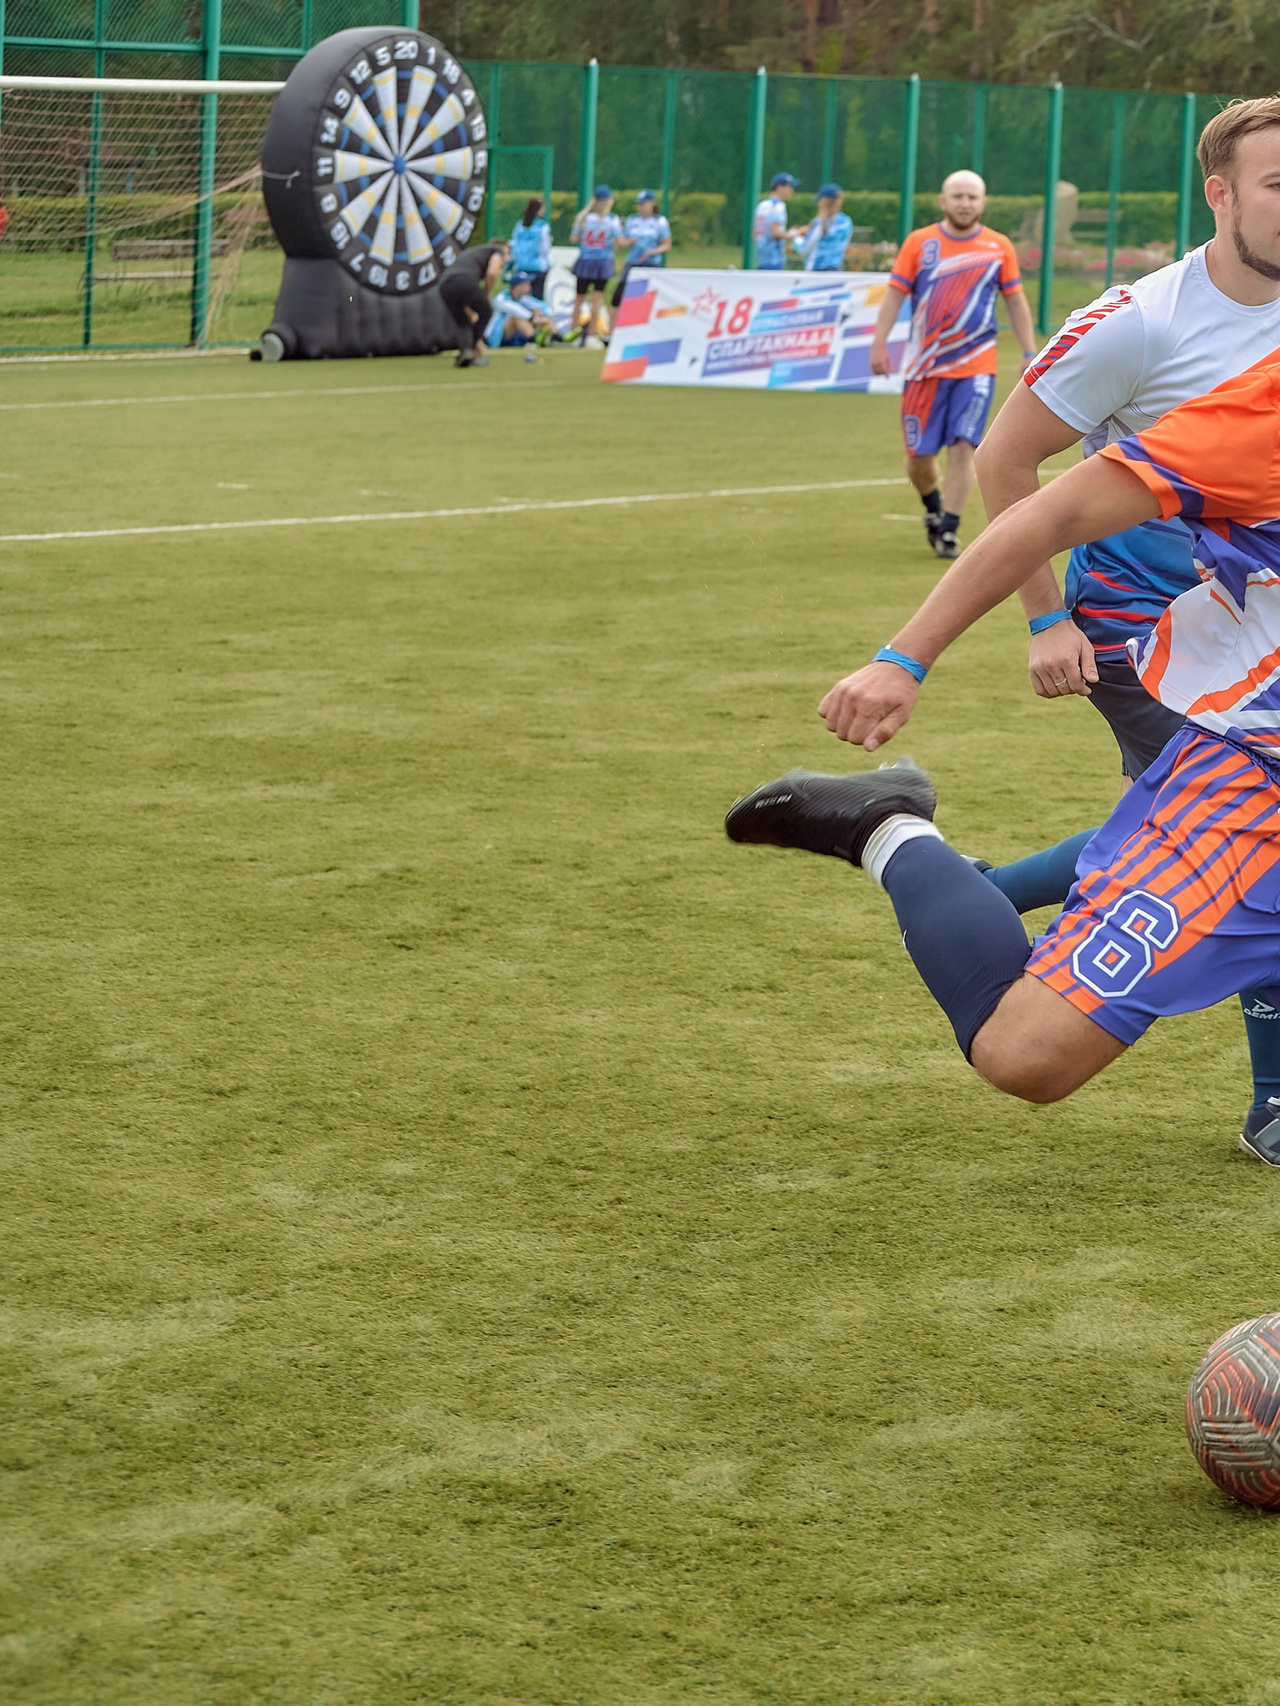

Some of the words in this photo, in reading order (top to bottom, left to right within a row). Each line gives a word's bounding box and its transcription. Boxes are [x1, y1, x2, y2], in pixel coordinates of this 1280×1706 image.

[375, 46, 391, 66] 5
[393, 41, 418, 60] 20
[427, 47, 436, 65] 1
[349, 60, 372, 84] 12
[333, 88, 351, 109] 9
[461, 88, 475, 106] 4
[320, 117, 339, 143] 14
[317, 156, 333, 177] 11
[320, 192, 338, 213] 8
[467, 185, 485, 212] 10
[349, 252, 365, 272] 7
[440, 245, 456, 267] 2
[395, 270, 410, 291] 3
[417, 262, 437, 286] 17
[707, 297, 753, 338] 18
[709, 328, 834, 360] СПАРТАКИАДА
[1072, 889, 1179, 998] 6
